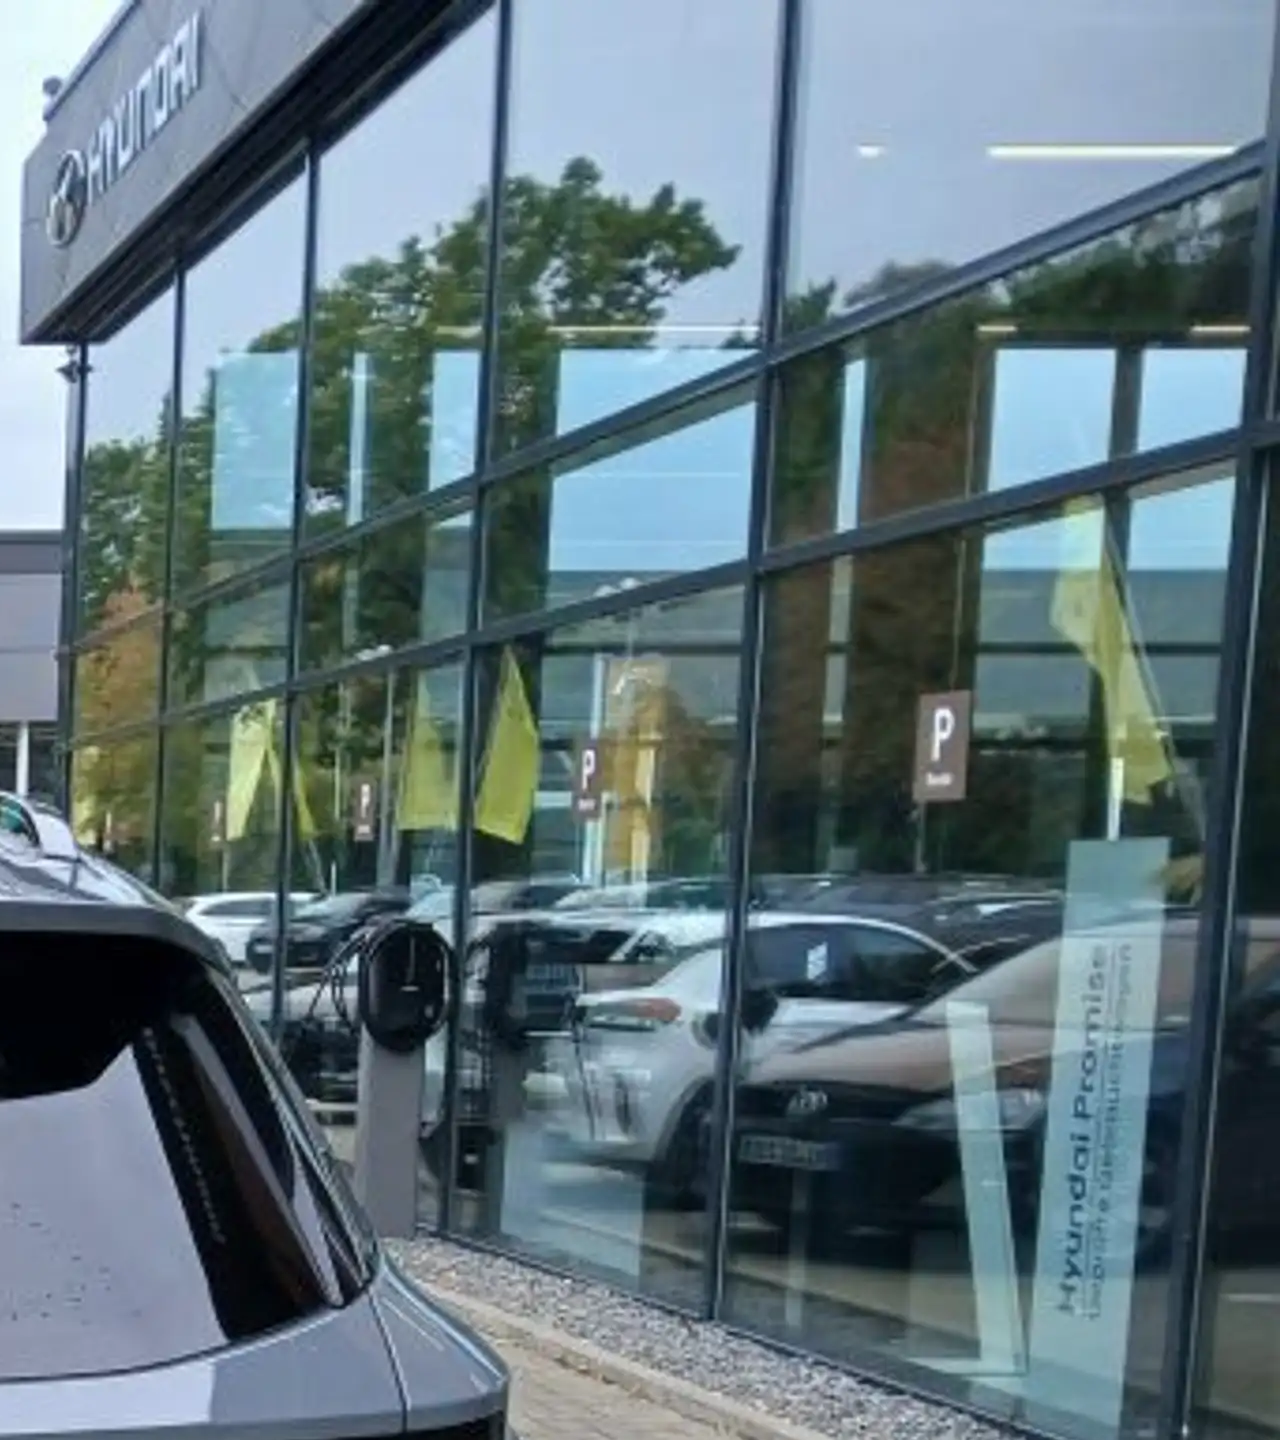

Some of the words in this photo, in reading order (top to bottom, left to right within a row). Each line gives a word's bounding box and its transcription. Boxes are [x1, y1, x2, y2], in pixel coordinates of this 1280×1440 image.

[88, 11, 201, 205] HYUNDAI
[581, 749, 596, 792] P
[931, 707, 956, 761] P
[1071, 946, 1106, 1120] Promise
[1056, 1132, 1092, 1316] Hyundai
